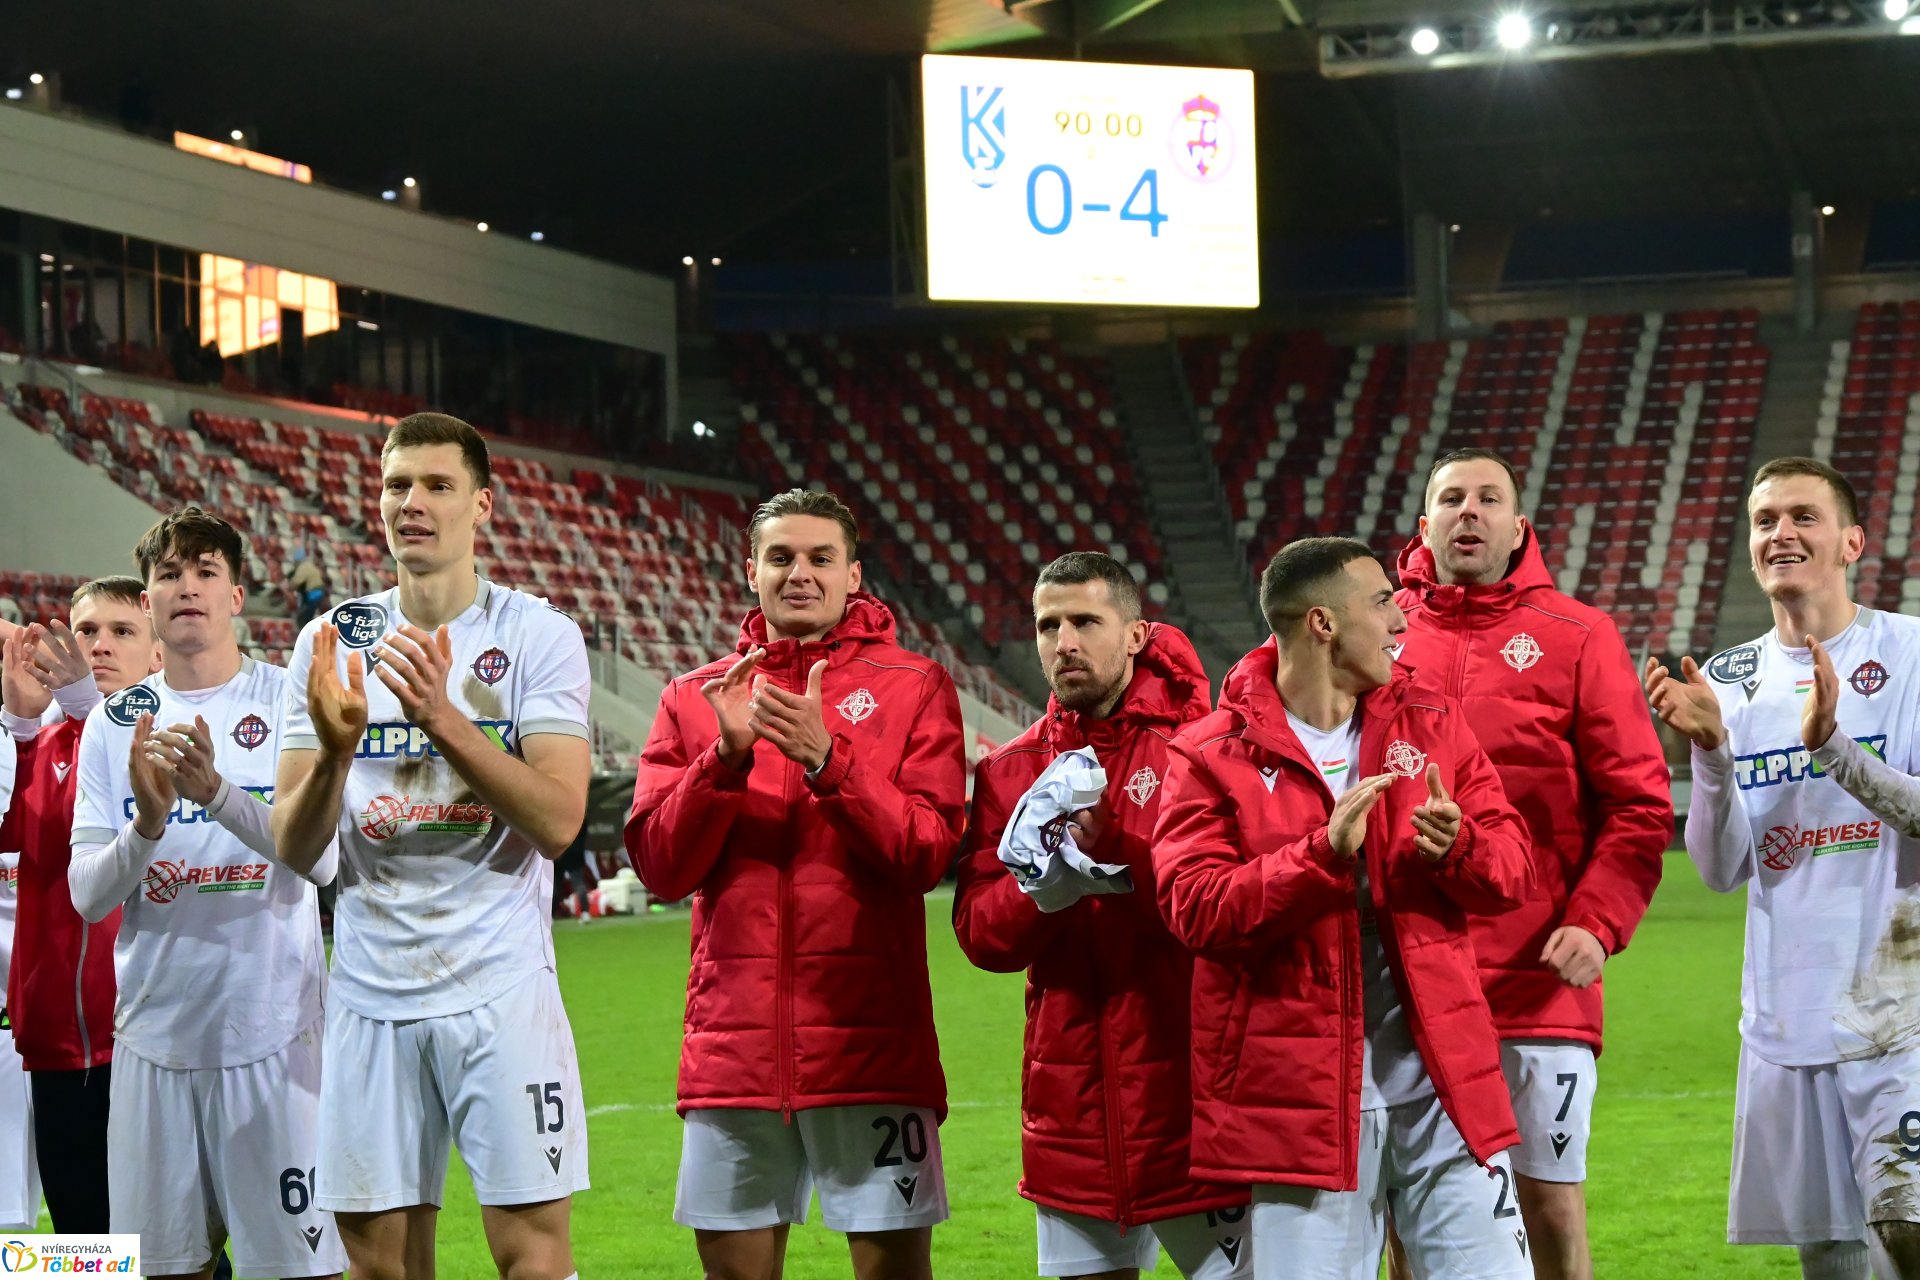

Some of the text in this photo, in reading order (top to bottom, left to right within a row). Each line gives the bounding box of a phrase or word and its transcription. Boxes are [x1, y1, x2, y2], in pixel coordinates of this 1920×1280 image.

[351, 627, 378, 641] liga
[354, 615, 381, 627] fizz
[1728, 661, 1754, 675] liga
[1730, 650, 1755, 663] fizz
[126, 695, 152, 705] fizz
[526, 1081, 564, 1135] 15
[1554, 1072, 1578, 1122] 7
[871, 1112, 928, 1169] 20
[279, 1166, 316, 1216] 6
[1488, 1162, 1522, 1220] 2
